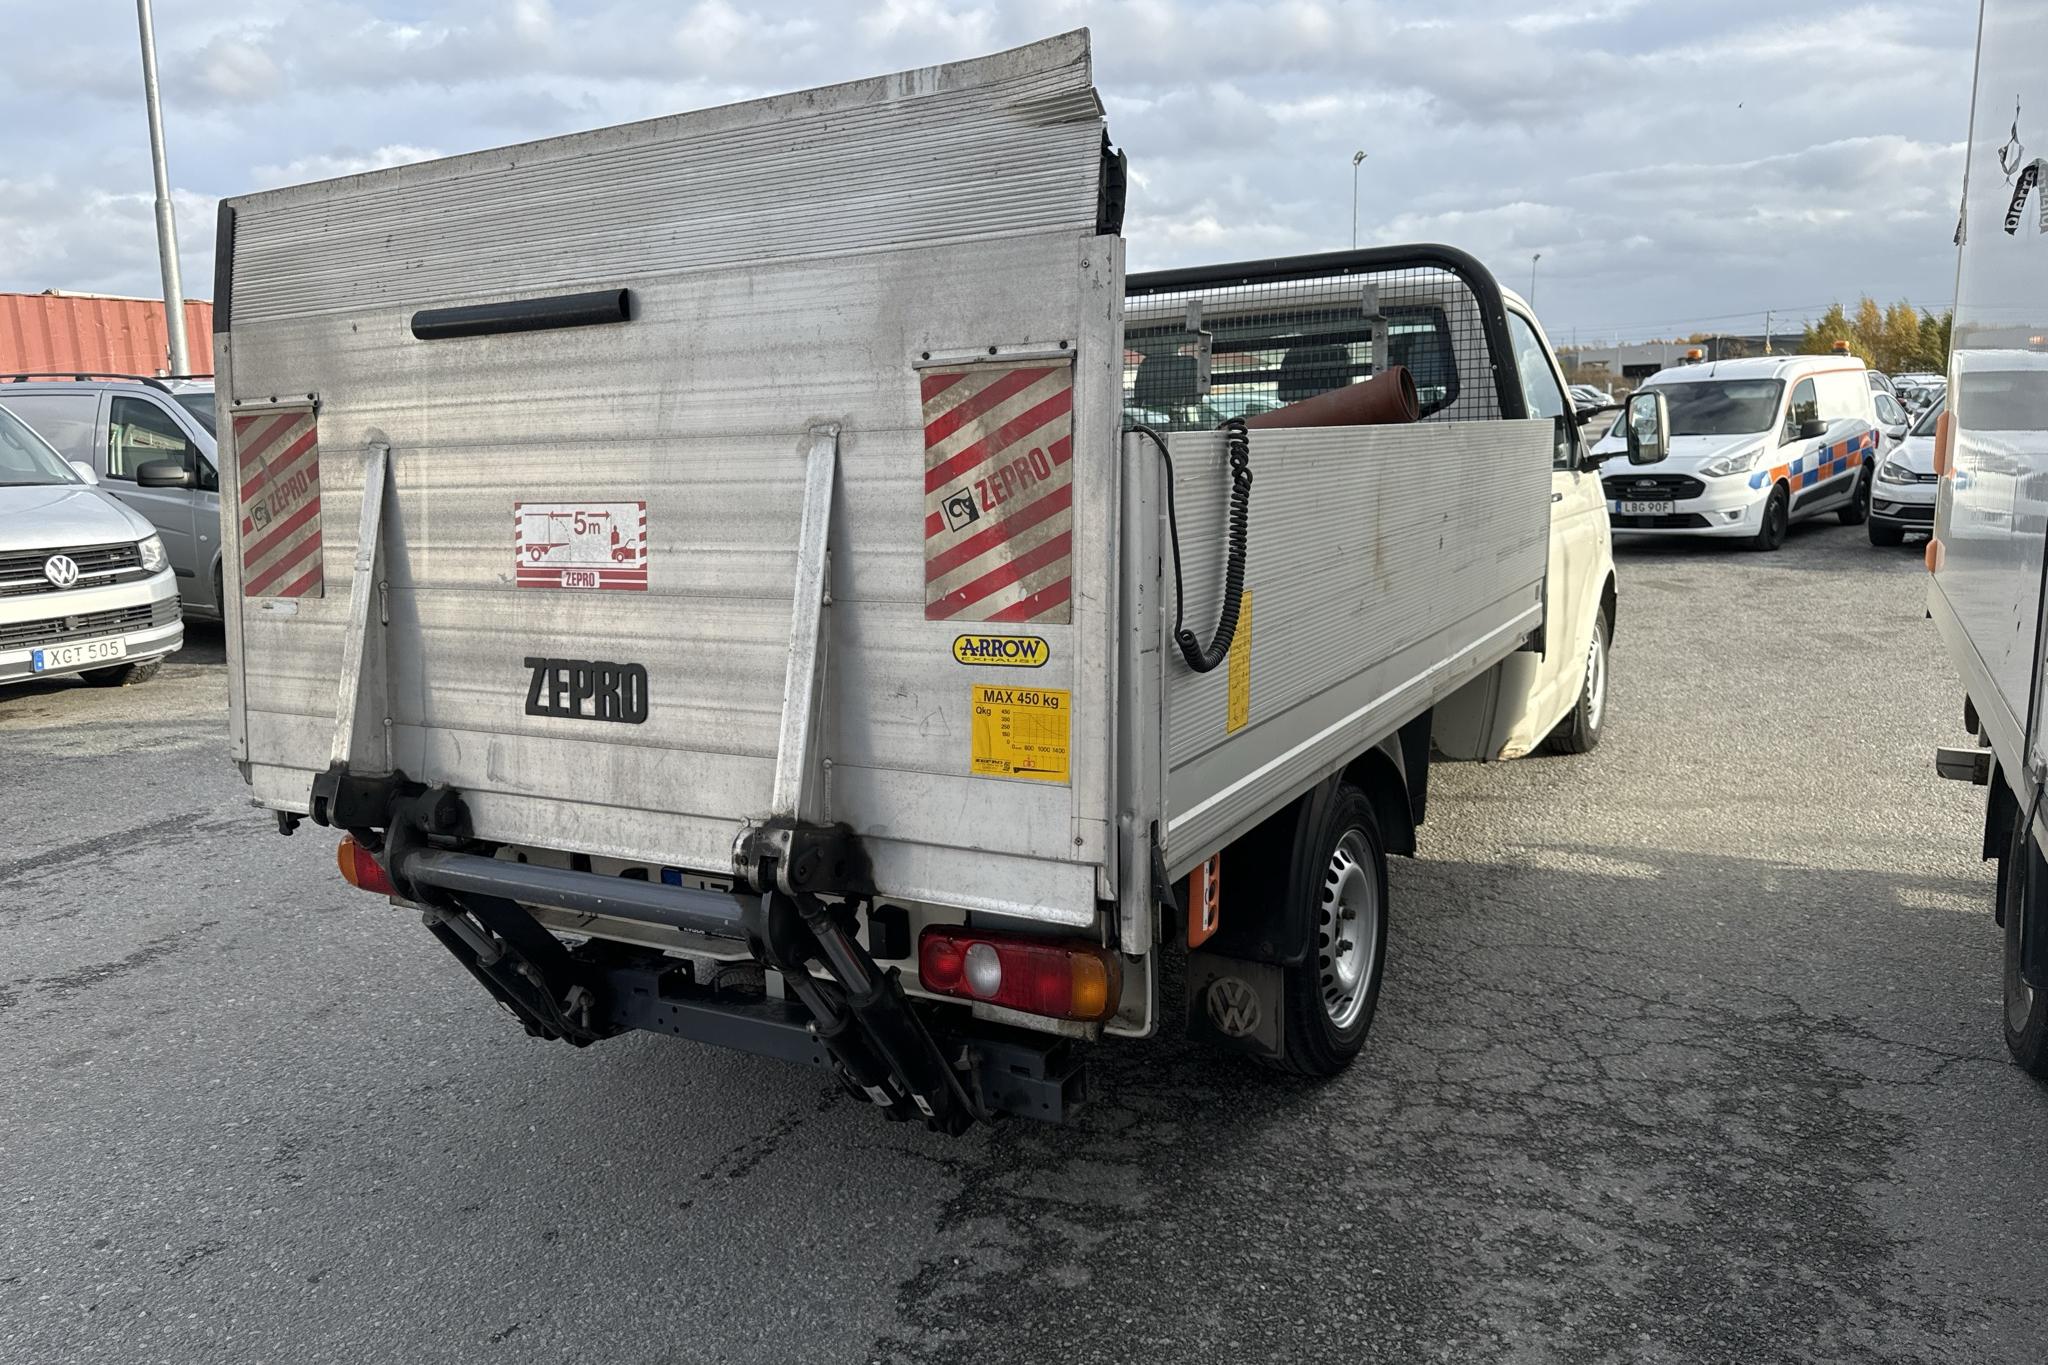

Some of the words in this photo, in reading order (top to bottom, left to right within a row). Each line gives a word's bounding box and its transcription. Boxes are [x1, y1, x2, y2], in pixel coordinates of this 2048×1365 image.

[974, 447, 1051, 513] ZEPRO
[267, 469, 309, 518] ZEPRO
[1624, 502, 1645, 513] LBG
[1647, 502, 1669, 513] 90F
[565, 572, 595, 587] ZEPRO
[50, 646, 83, 667] XGT
[88, 641, 119, 659] 505
[960, 638, 1041, 659] ARROW
[523, 656, 649, 725] ZEPRO
[983, 689, 1013, 704] MAX
[1017, 692, 1040, 705] 450
[1043, 693, 1059, 709] kg
[975, 706, 992, 717] Qkg
